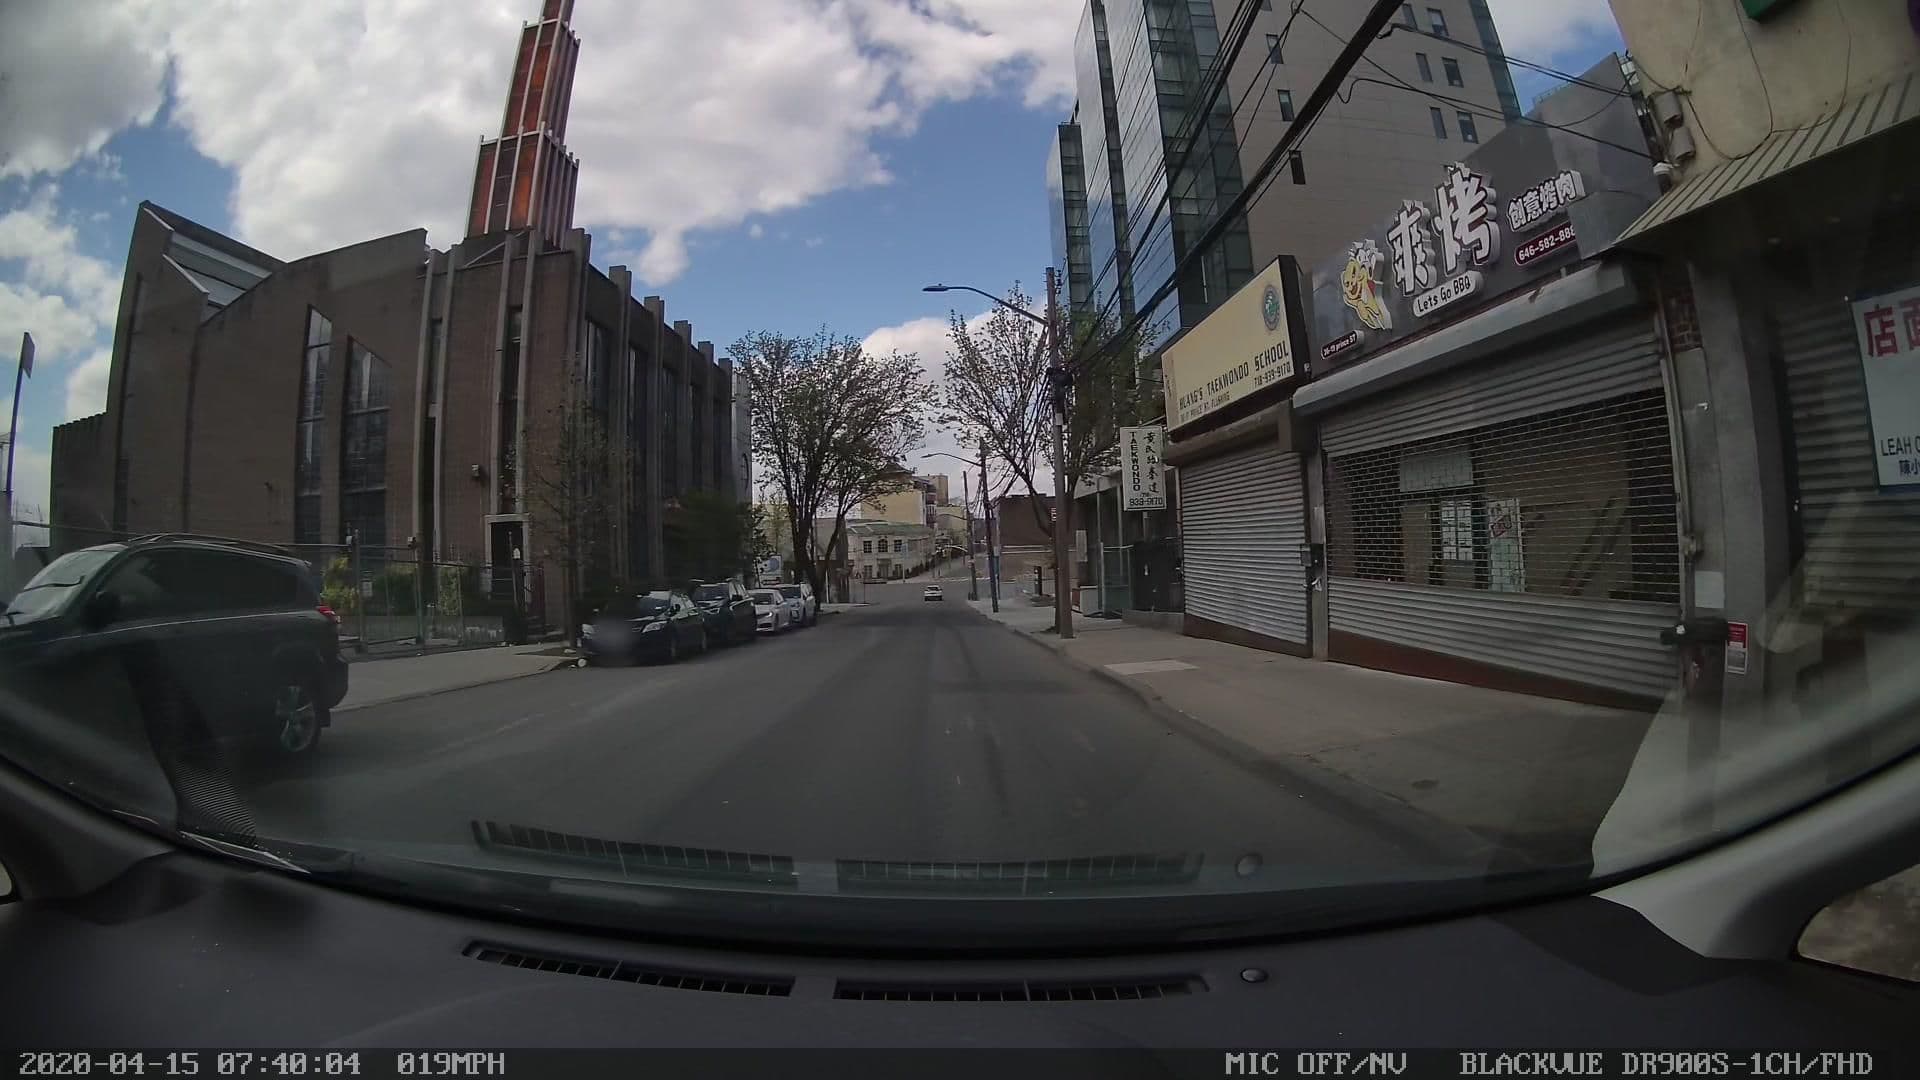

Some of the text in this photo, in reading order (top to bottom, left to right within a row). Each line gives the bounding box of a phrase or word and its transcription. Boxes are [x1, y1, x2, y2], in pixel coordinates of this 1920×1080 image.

[1508, 172, 1576, 229] 创意烤肉
[1417, 274, 1472, 313] Lets Go BBQ
[1206, 361, 1250, 395] TAEKWONDO
[1255, 340, 1289, 372] SCHOOL
[1129, 431, 1141, 492] TAEKWONDO
[1880, 435, 1913, 457] LEAH
